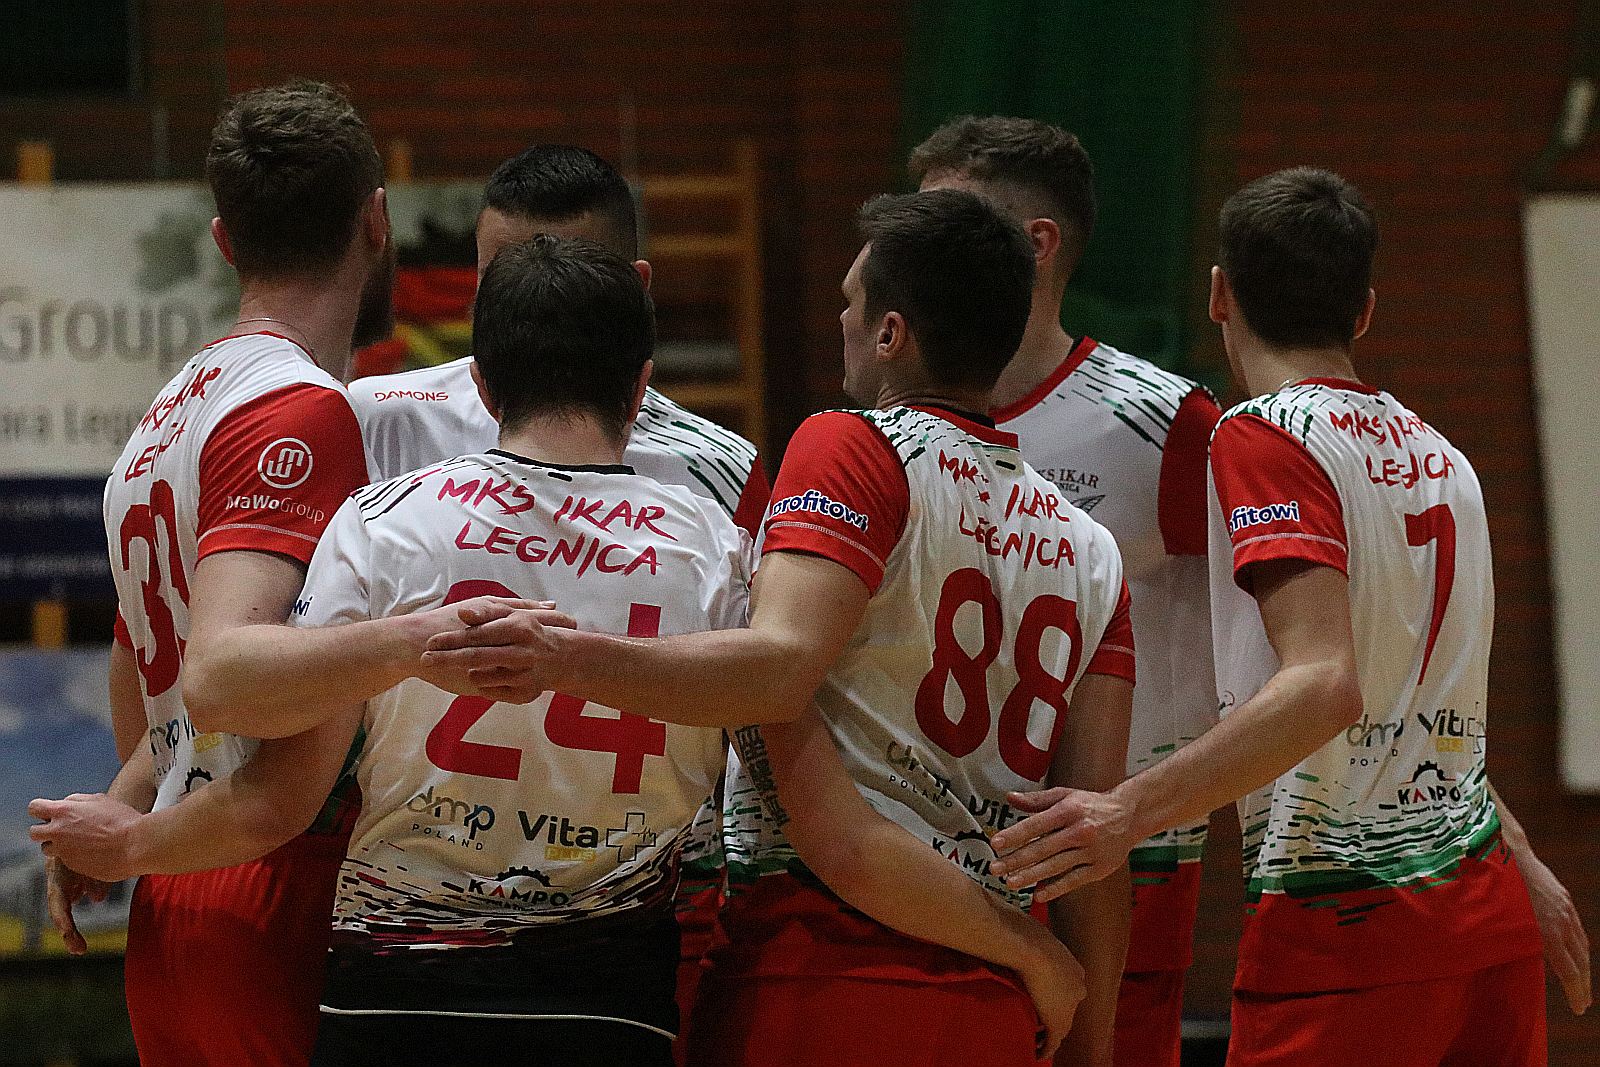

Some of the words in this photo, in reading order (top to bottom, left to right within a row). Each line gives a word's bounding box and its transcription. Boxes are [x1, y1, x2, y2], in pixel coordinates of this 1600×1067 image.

[374, 390, 449, 403] DAMONS
[1059, 468, 1099, 489] IKAR
[225, 494, 325, 525] MaWoGroup
[437, 478, 536, 518] MKS
[553, 495, 679, 542] IKAR
[773, 490, 868, 533] profitowi
[454, 520, 662, 579] LEGNICA
[1403, 503, 1456, 686] 7
[425, 579, 667, 794] 24
[914, 567, 1083, 781] 88
[889, 774, 953, 808] POLAND
[406, 786, 496, 841] dmp
[517, 810, 600, 849] Vita
[411, 823, 484, 851] POLAND
[932, 836, 1008, 885] KAM
[468, 878, 570, 907] KAMPO
